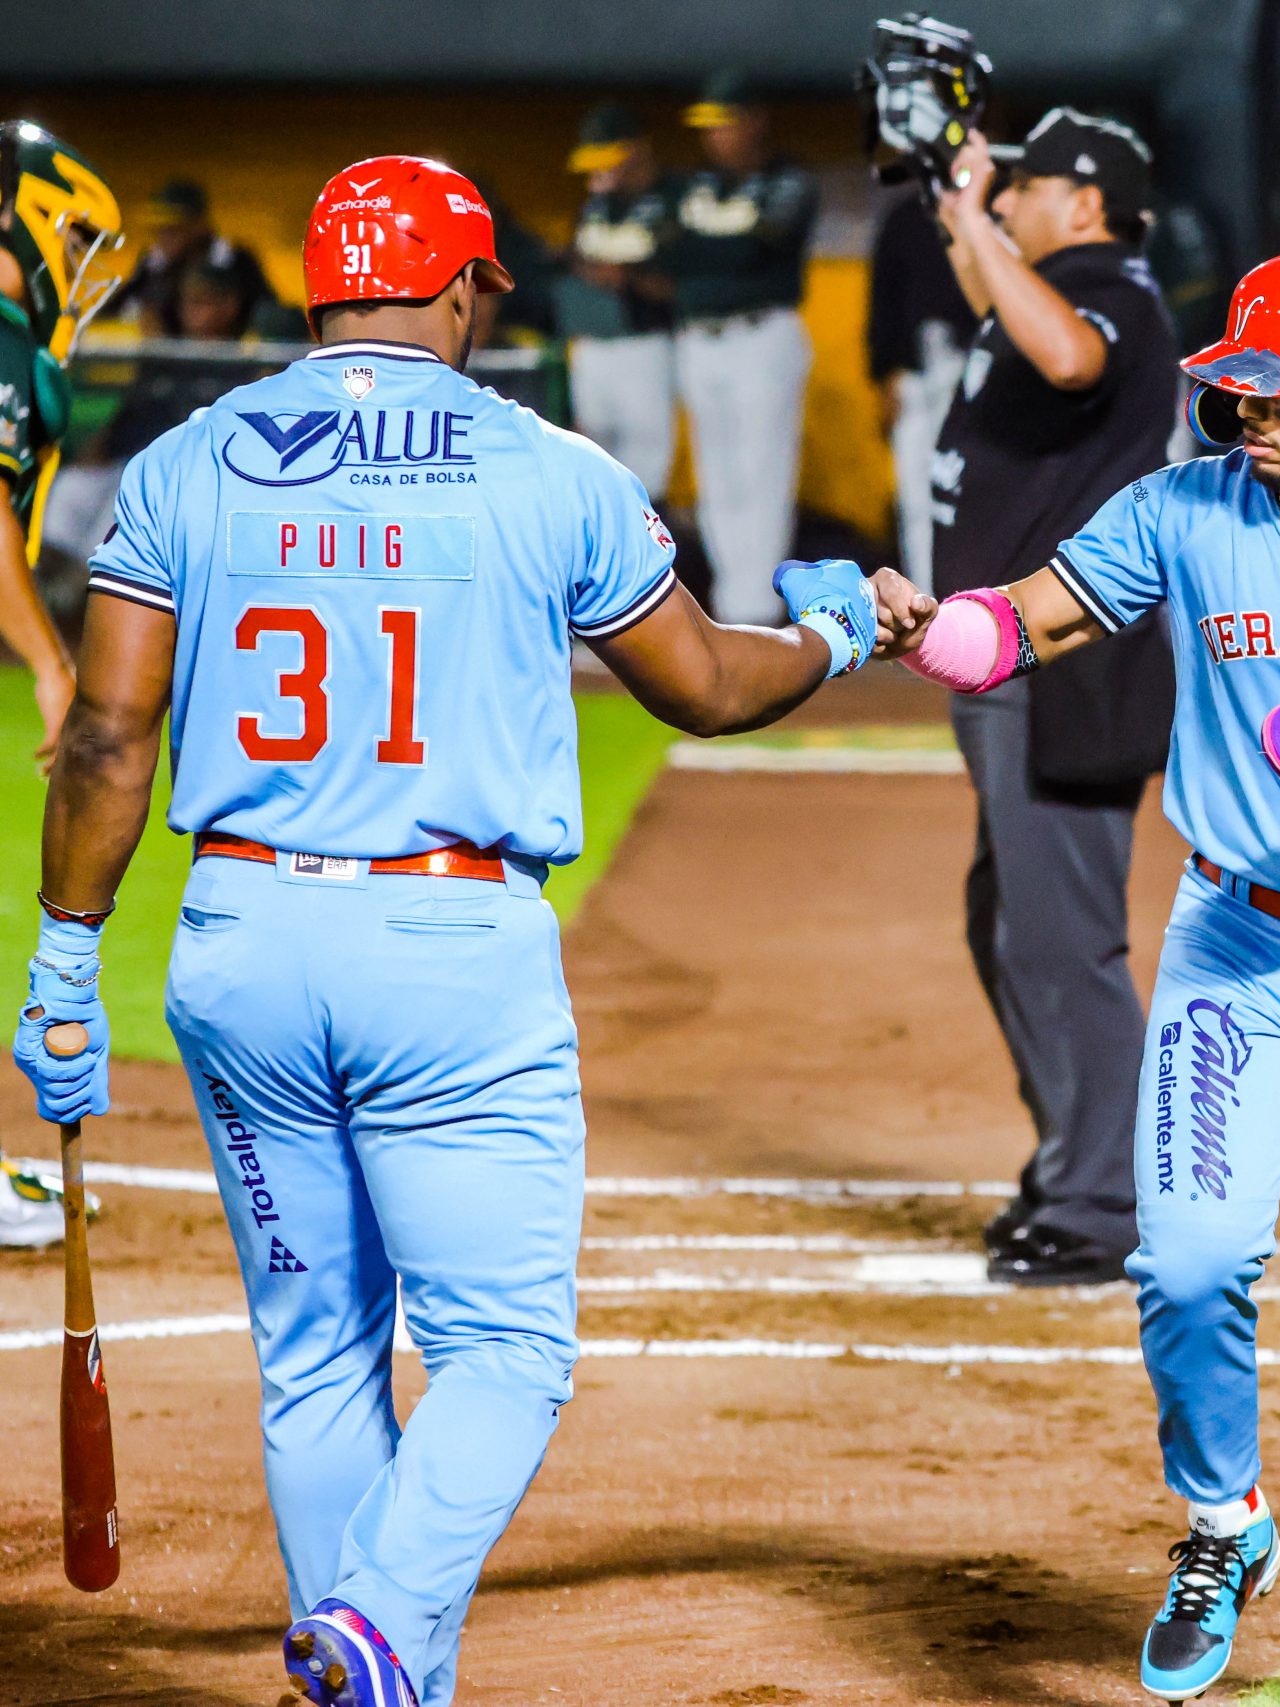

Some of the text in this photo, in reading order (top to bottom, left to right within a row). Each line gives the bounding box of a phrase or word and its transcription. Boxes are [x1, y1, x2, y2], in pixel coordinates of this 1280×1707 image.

[343, 244, 371, 274] 31
[344, 367, 373, 379] LMB
[234, 410, 474, 474] VALUE
[350, 472, 477, 486] CASA DE BOLSA
[280, 522, 403, 569] PUIG
[234, 602, 428, 767] 31
[1156, 1048, 1177, 1195] caliente.mx
[1187, 998, 1252, 1201] Caliente
[202, 1071, 280, 1230] Totalplay
